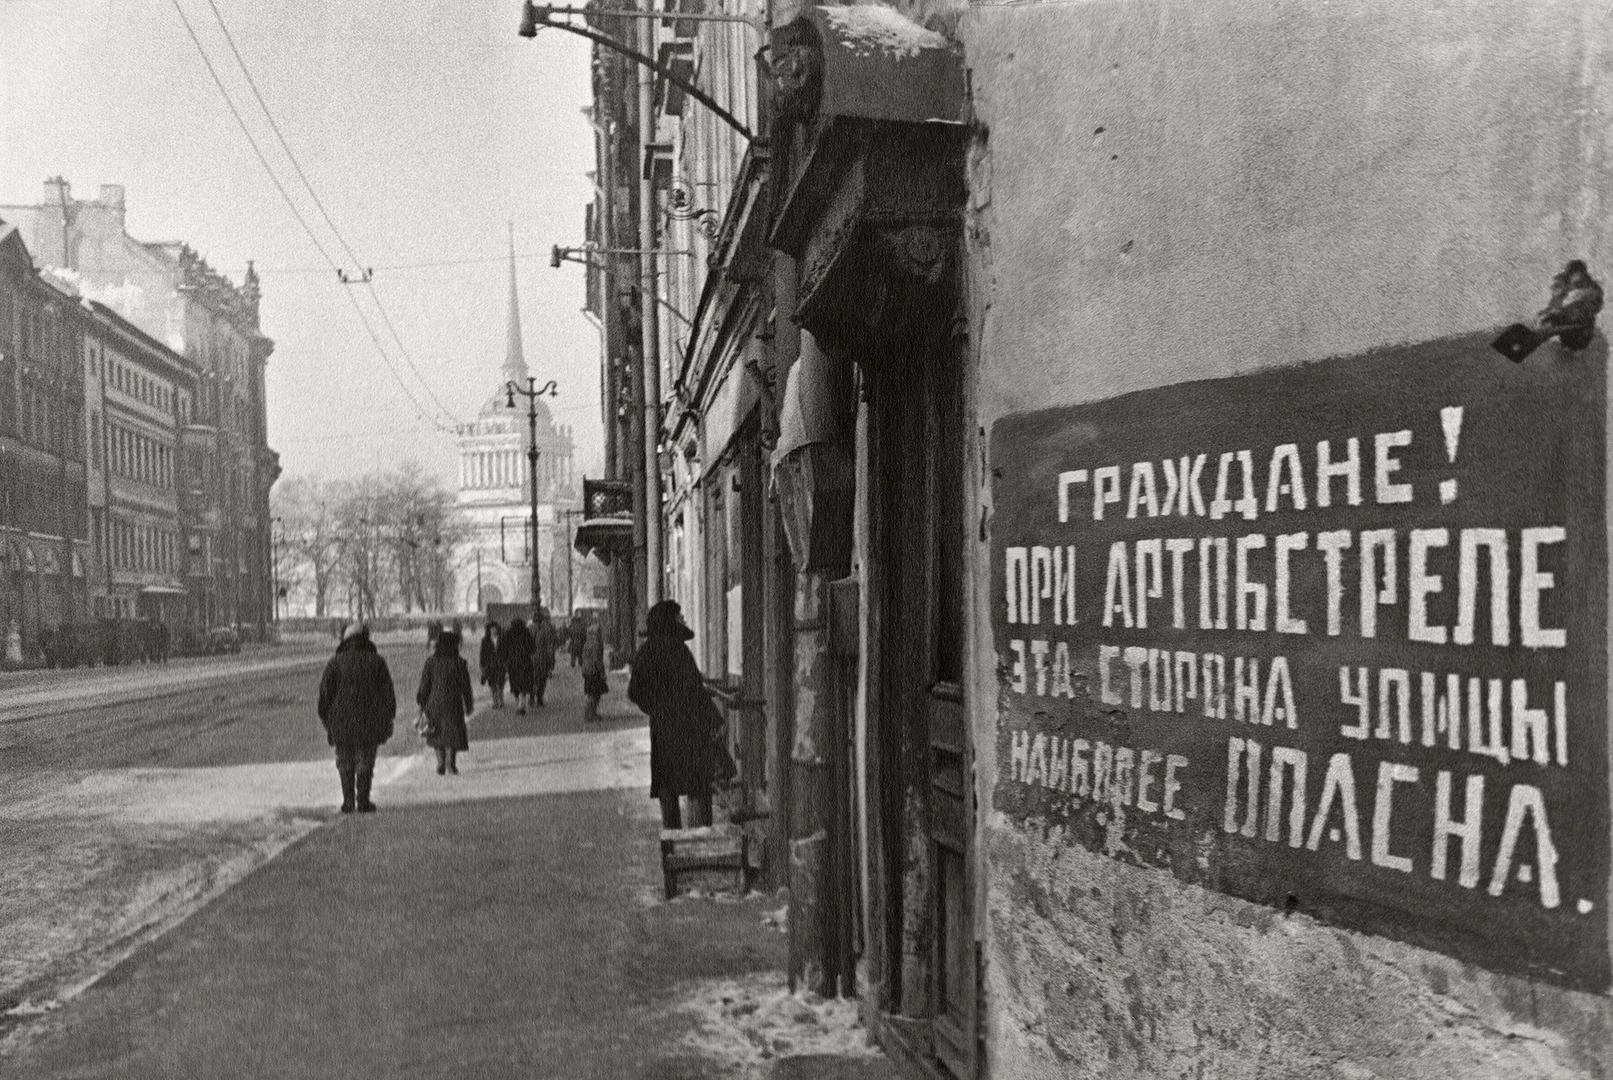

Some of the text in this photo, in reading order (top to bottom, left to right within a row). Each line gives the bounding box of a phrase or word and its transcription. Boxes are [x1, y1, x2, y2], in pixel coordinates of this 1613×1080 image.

[1005, 526, 1567, 648] ПРИ АРТОБСТРЕЛЕ
[1009, 639, 1569, 767] ЭТА СТОРОНА УЛИЦЫ
